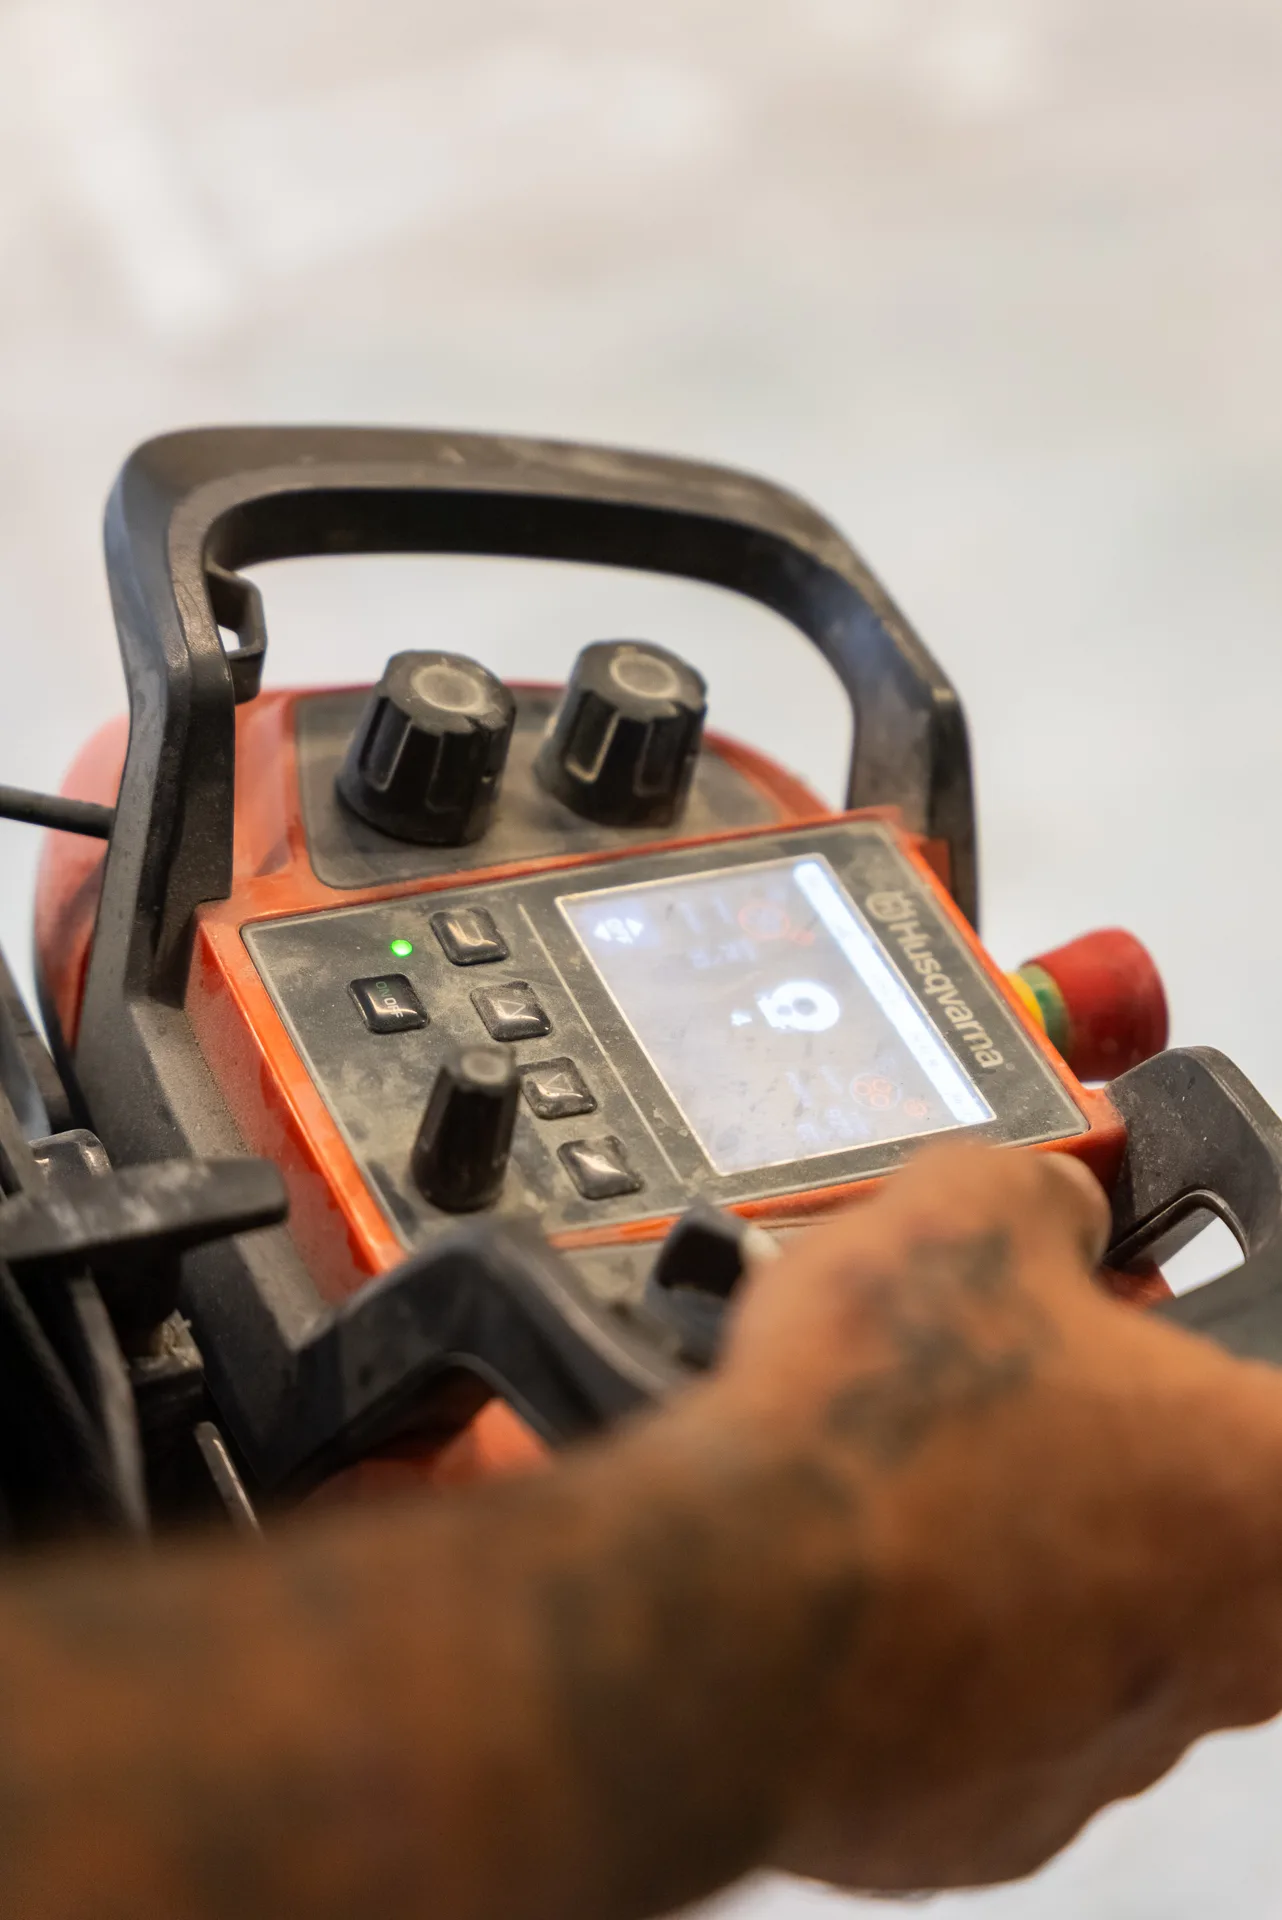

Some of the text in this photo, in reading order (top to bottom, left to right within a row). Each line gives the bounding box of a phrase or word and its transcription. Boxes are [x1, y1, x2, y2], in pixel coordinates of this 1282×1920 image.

[375, 981, 404, 1018] ON OFF
[888, 920, 1004, 1068] Husqvarna
